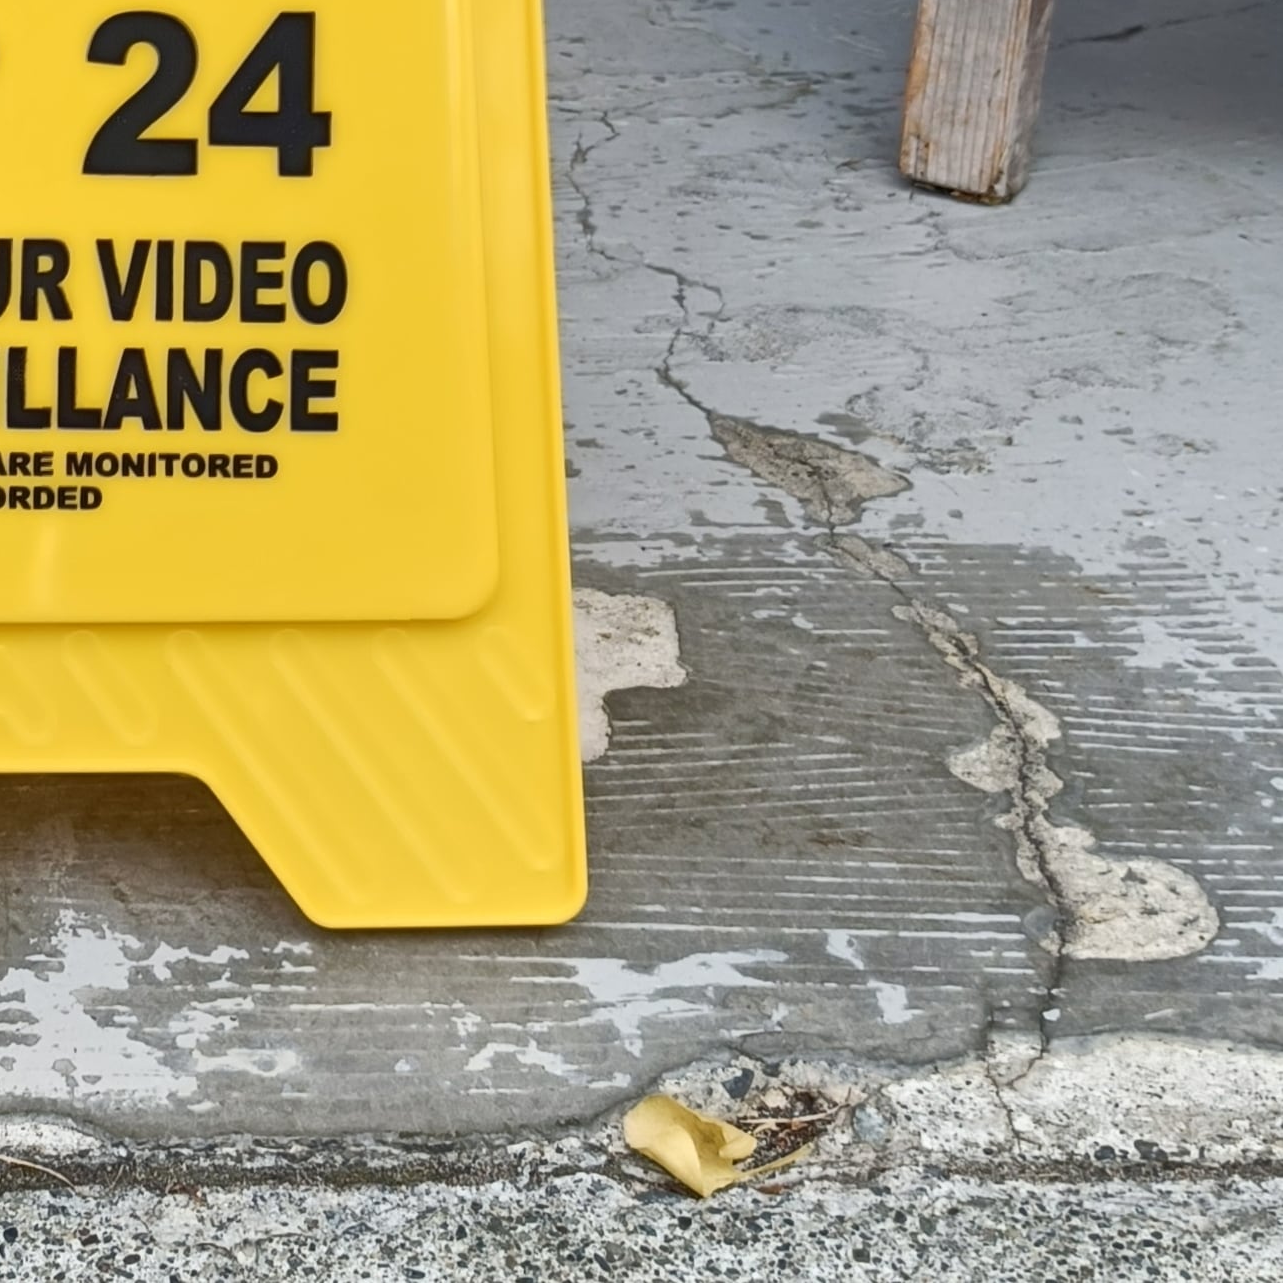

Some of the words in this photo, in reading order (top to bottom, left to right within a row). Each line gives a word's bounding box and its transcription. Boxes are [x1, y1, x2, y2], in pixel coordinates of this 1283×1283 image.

[82, 10, 332, 178] 24
[96, 239, 348, 325] VIDEO
[65, 452, 278, 479] MONITORED
